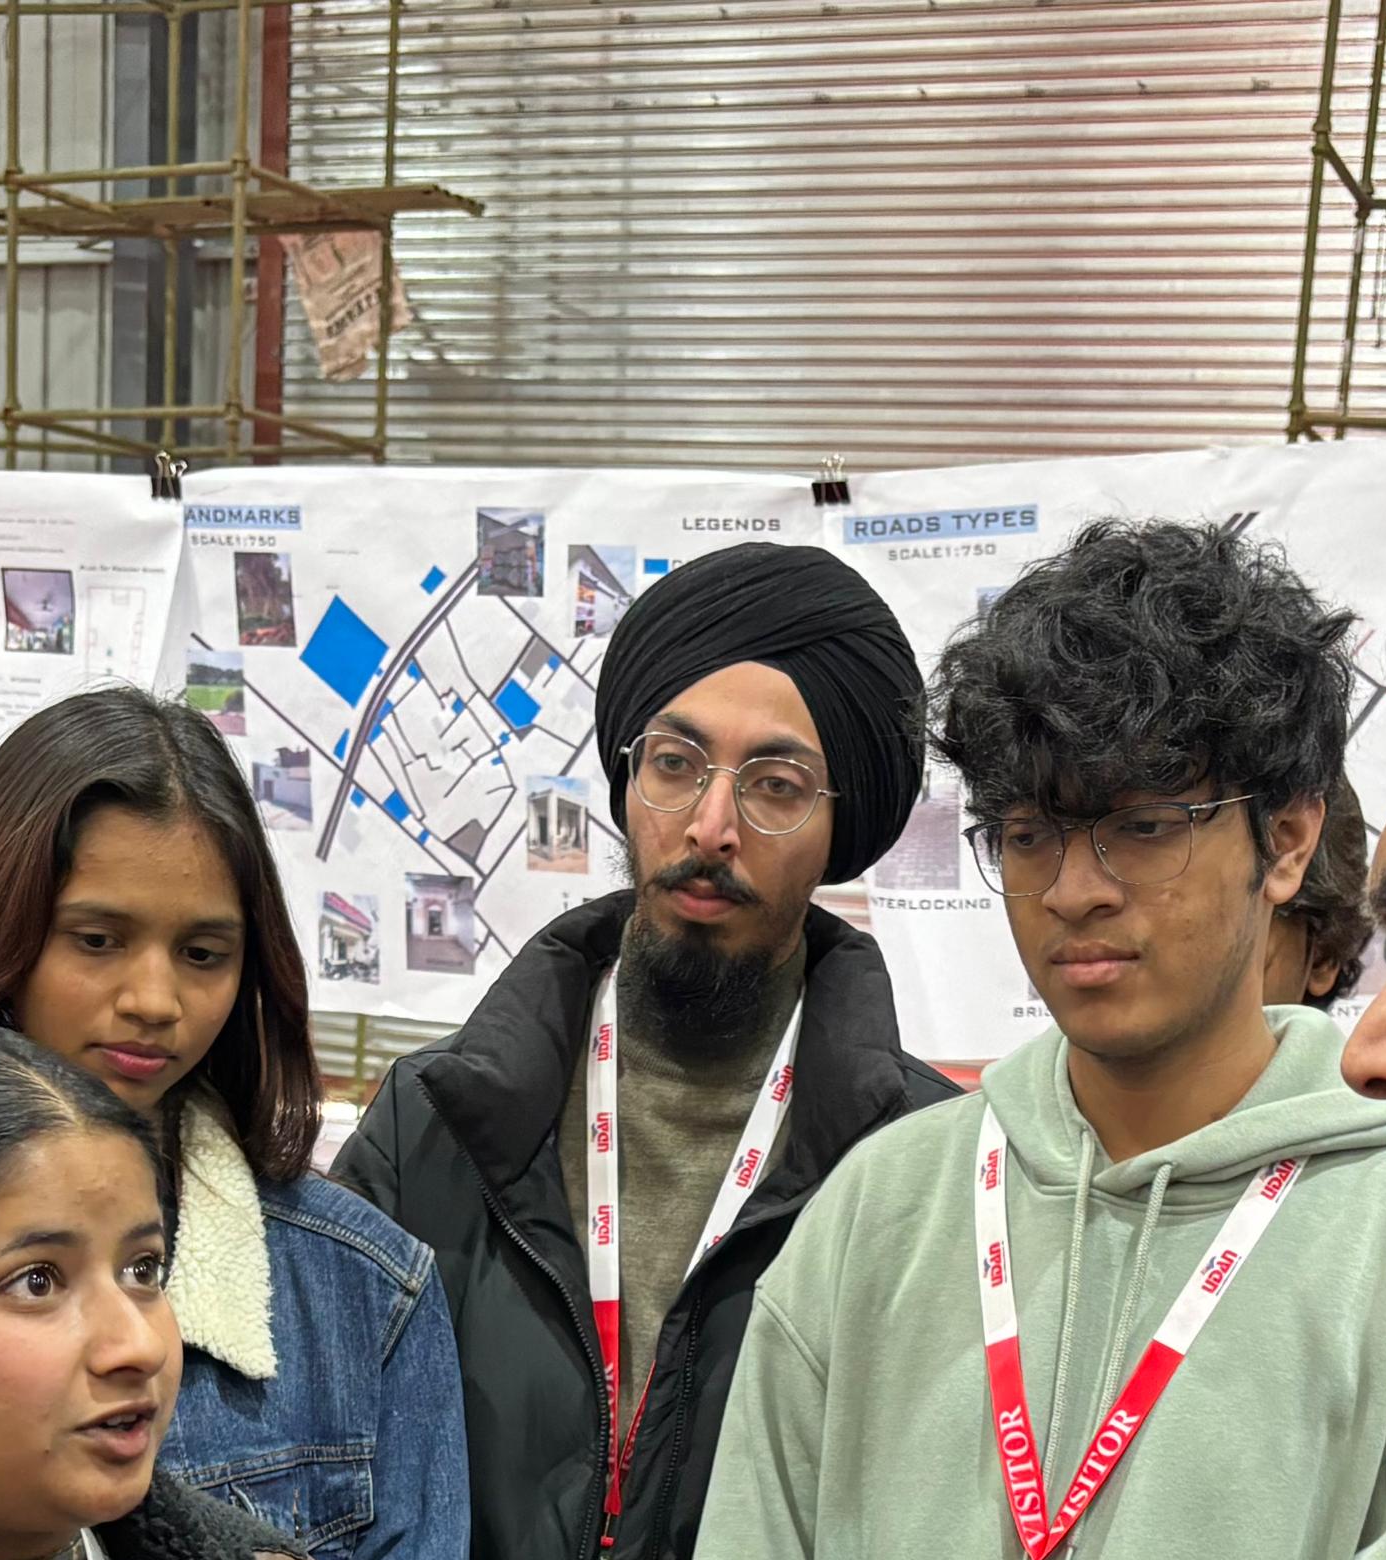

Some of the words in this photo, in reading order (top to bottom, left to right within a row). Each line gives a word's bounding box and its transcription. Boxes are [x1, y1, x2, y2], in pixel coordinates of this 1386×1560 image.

[184, 508, 301, 525] ANDMARKS
[682, 517, 781, 531] LEGENDS
[853, 516, 941, 537] ROADS
[952, 510, 1037, 531] TYPES
[888, 543, 997, 561] SCALE1:750
[871, 896, 992, 911] NTERLOCKING
[597, 1024, 612, 1062] UDAN
[771, 1064, 794, 1103] UDAN
[597, 1112, 610, 1153] UDAN
[736, 1148, 761, 1188] UDAN
[986, 1148, 999, 1191] UDAN
[1261, 1158, 1297, 1201] UDAN
[598, 1205, 610, 1246] UDAN
[989, 1241, 1003, 1288] UDAN
[1201, 1249, 1238, 1294] UDAN
[999, 1404, 1045, 1548] VISITOR
[1049, 1407, 1140, 1538] VISITOR
